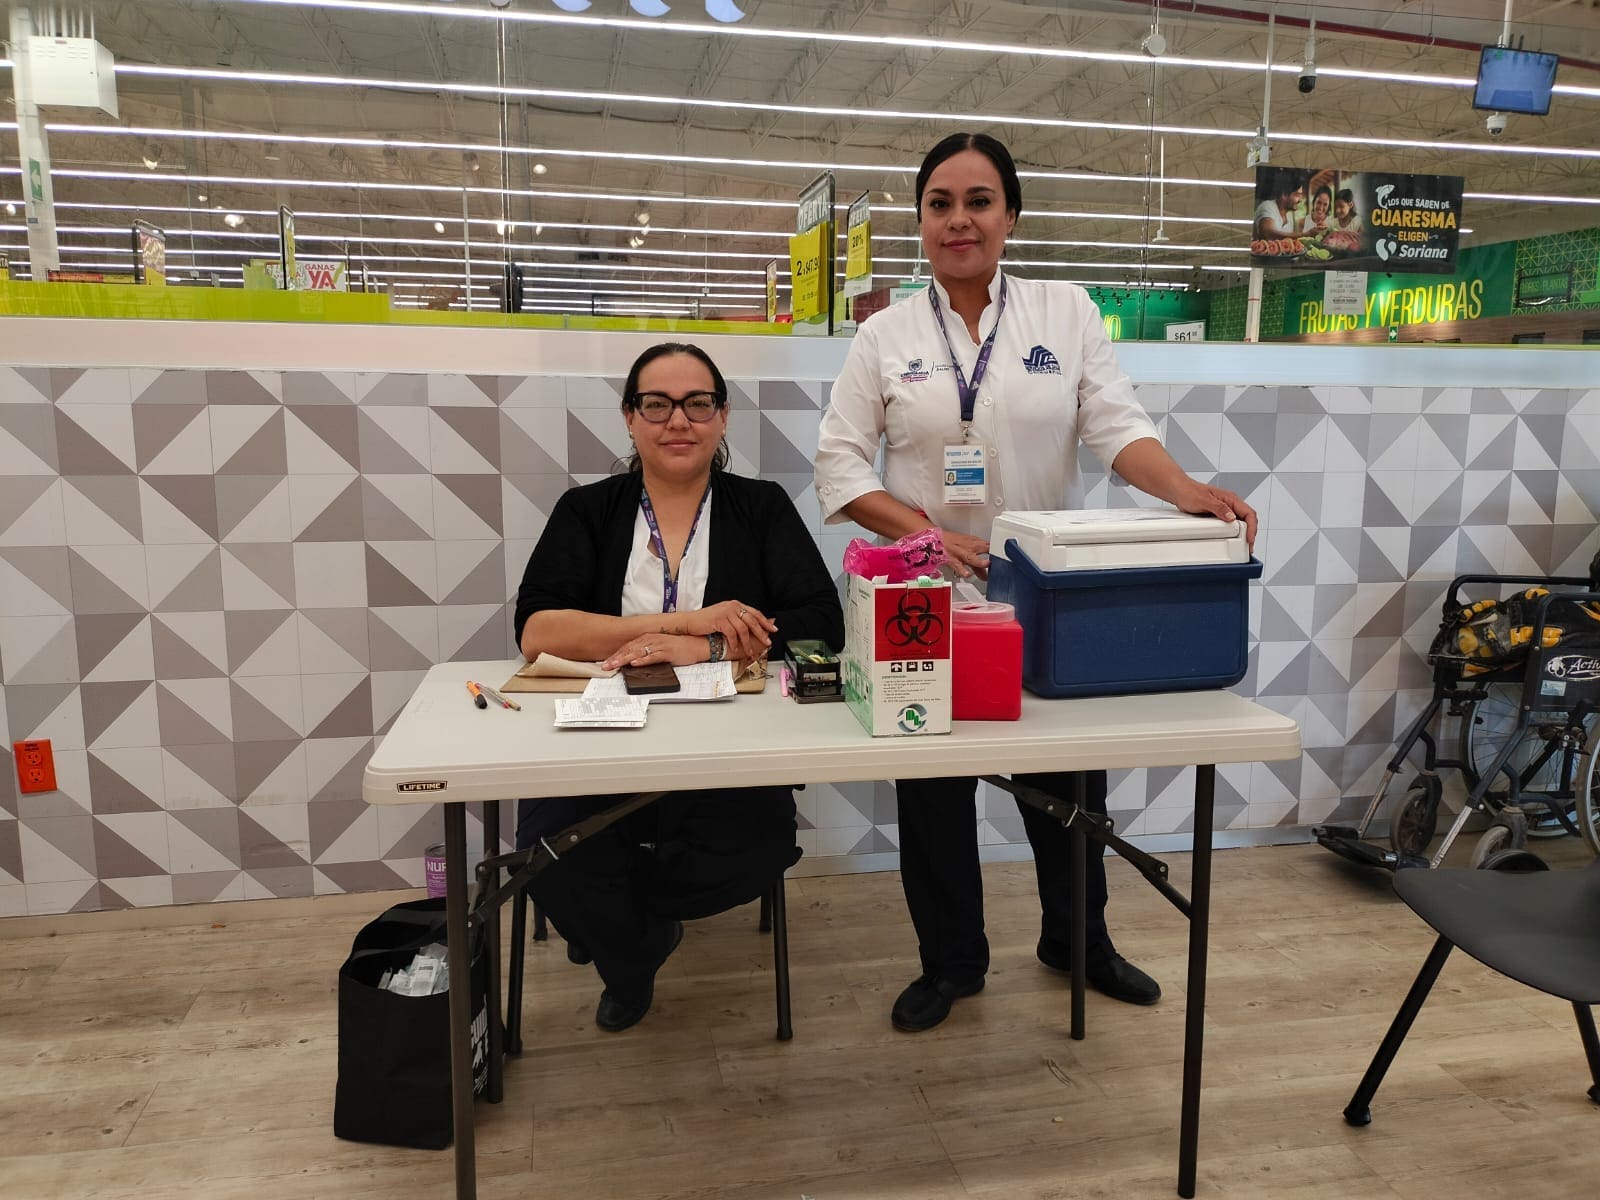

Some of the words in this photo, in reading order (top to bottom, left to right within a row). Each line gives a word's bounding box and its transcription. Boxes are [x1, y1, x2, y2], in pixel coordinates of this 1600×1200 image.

[1388, 198, 1399, 206] LOS
[1401, 198, 1414, 206] QUE
[1415, 199, 1440, 209] SABEN
[1441, 201, 1450, 209] DE
[798, 191, 828, 232] OFERTA
[1371, 208, 1457, 229] CUARESMA
[1398, 231, 1429, 241] ELIGEN
[1399, 244, 1448, 259] Soriana
[304, 263, 335, 271] GANAS
[308, 271, 337, 289] YA
[1365, 292, 1377, 328] Y
[1379, 279, 1483, 327] VERDURAS
[403, 783, 441, 791] LIFETIME
